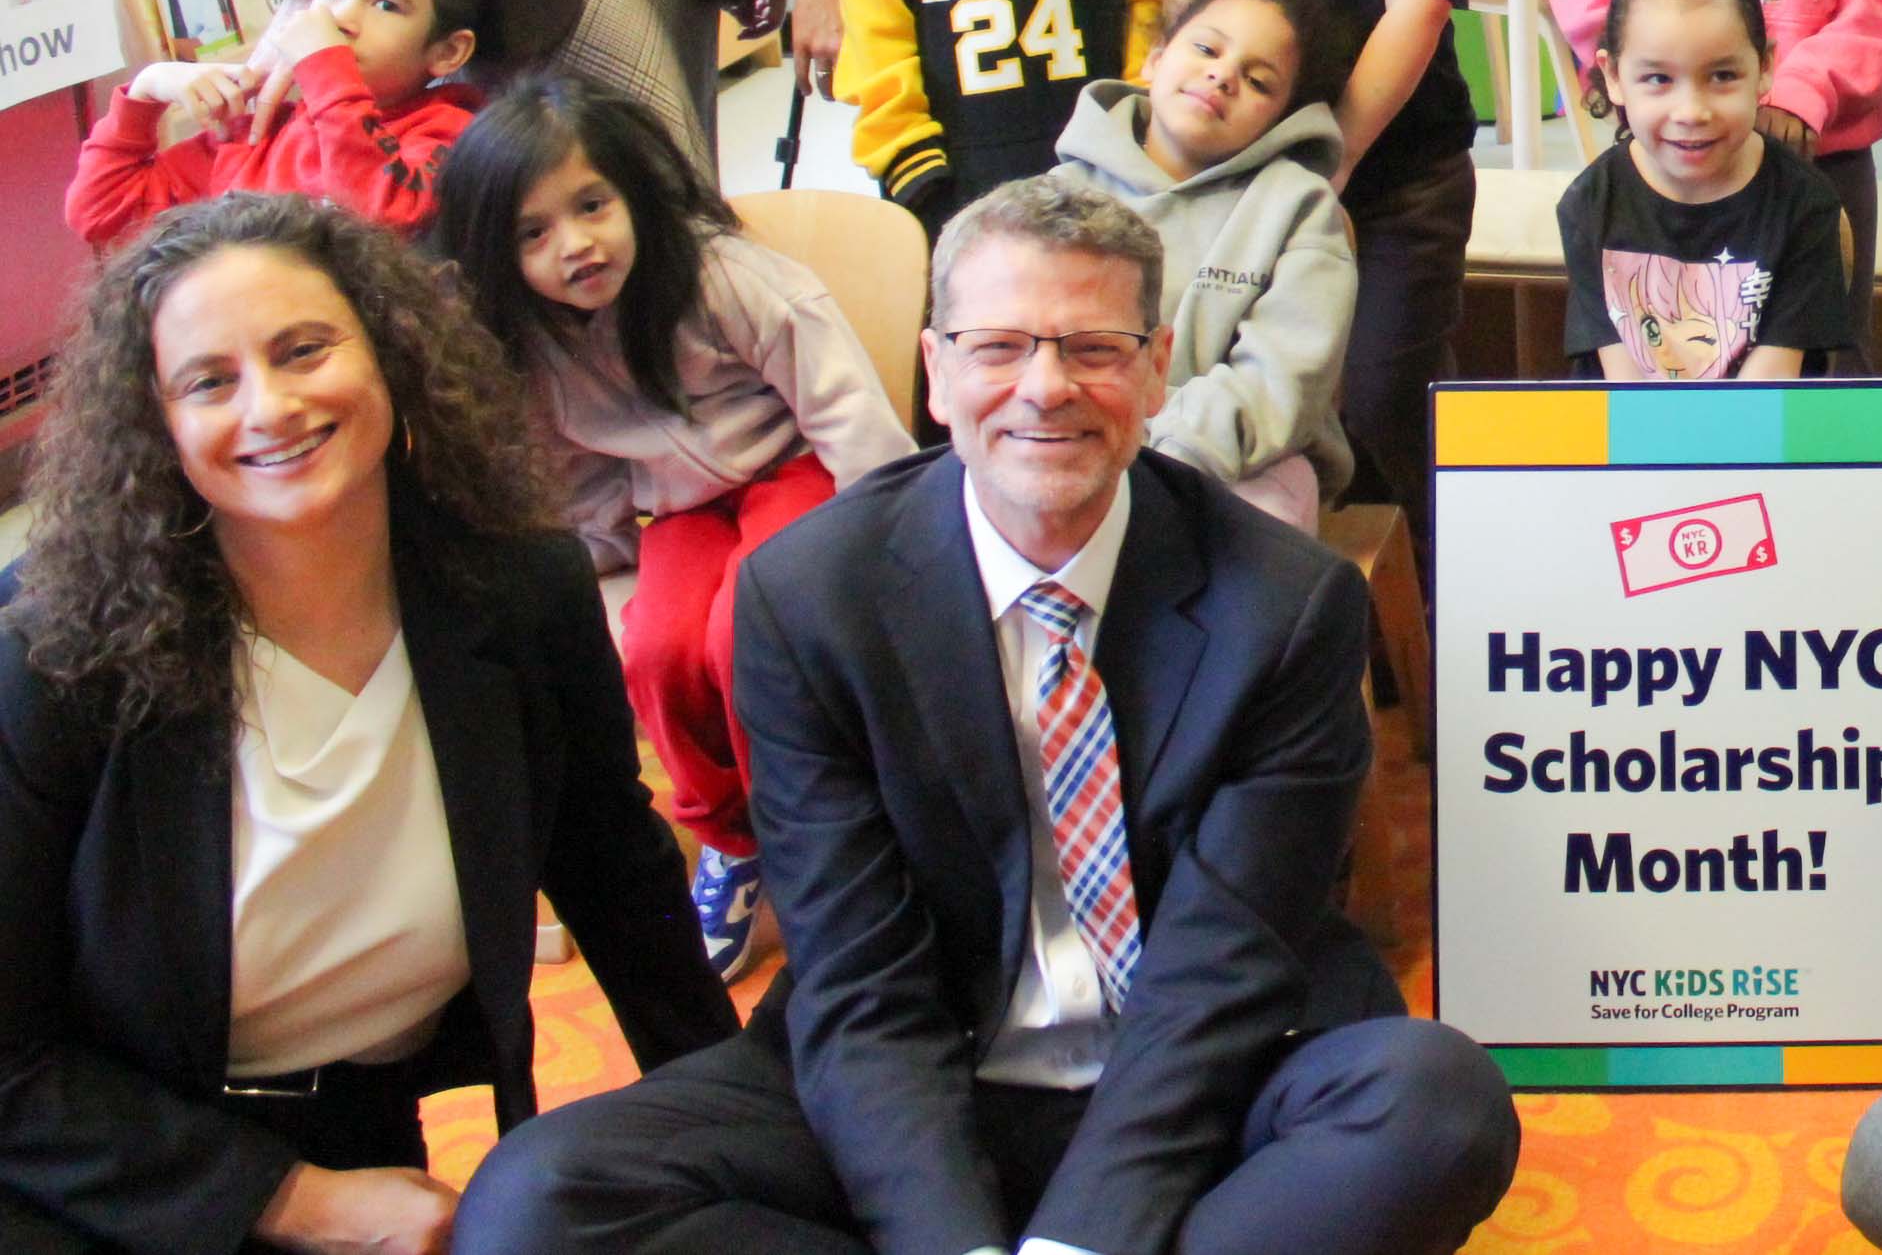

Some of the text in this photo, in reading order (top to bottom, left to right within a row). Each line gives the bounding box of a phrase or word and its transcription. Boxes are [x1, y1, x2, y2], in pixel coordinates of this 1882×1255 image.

[1680, 529, 1706, 541] NYC
[1683, 539, 1709, 559] KR
[1486, 631, 1723, 708] Happy
[1563, 829, 1828, 894] Month!
[1590, 970, 1647, 996] NYC
[1591, 1003, 1800, 1023] Save for College Program
